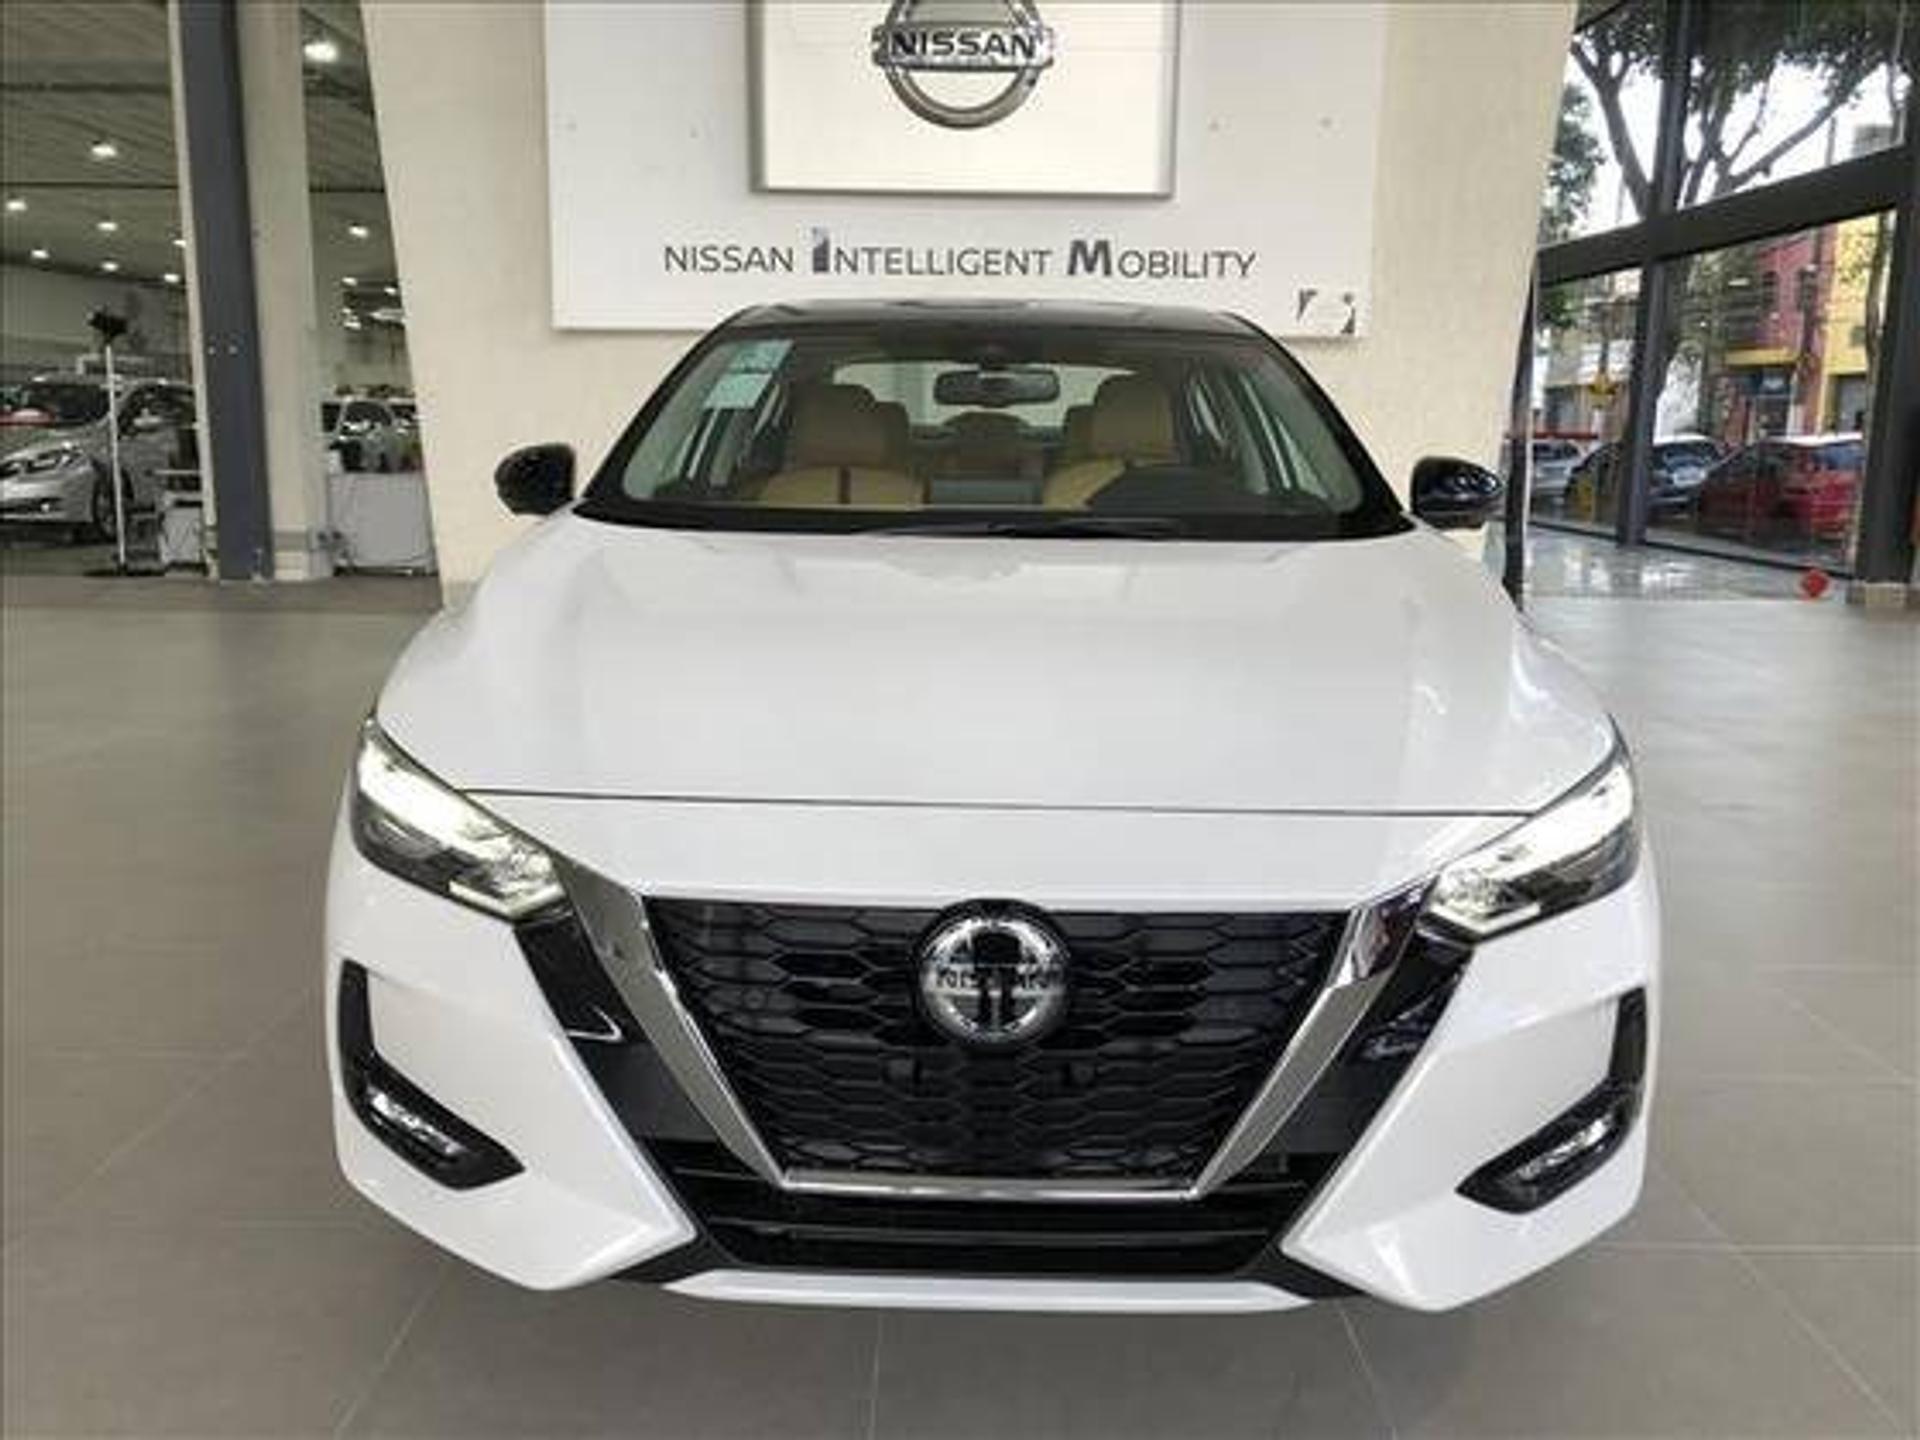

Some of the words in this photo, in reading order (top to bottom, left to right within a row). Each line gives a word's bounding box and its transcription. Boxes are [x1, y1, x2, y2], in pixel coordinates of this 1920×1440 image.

[891, 30, 1035, 58] NISSAN
[663, 245, 794, 273] NISSAN
[1067, 239, 1257, 279] MOBILITY
